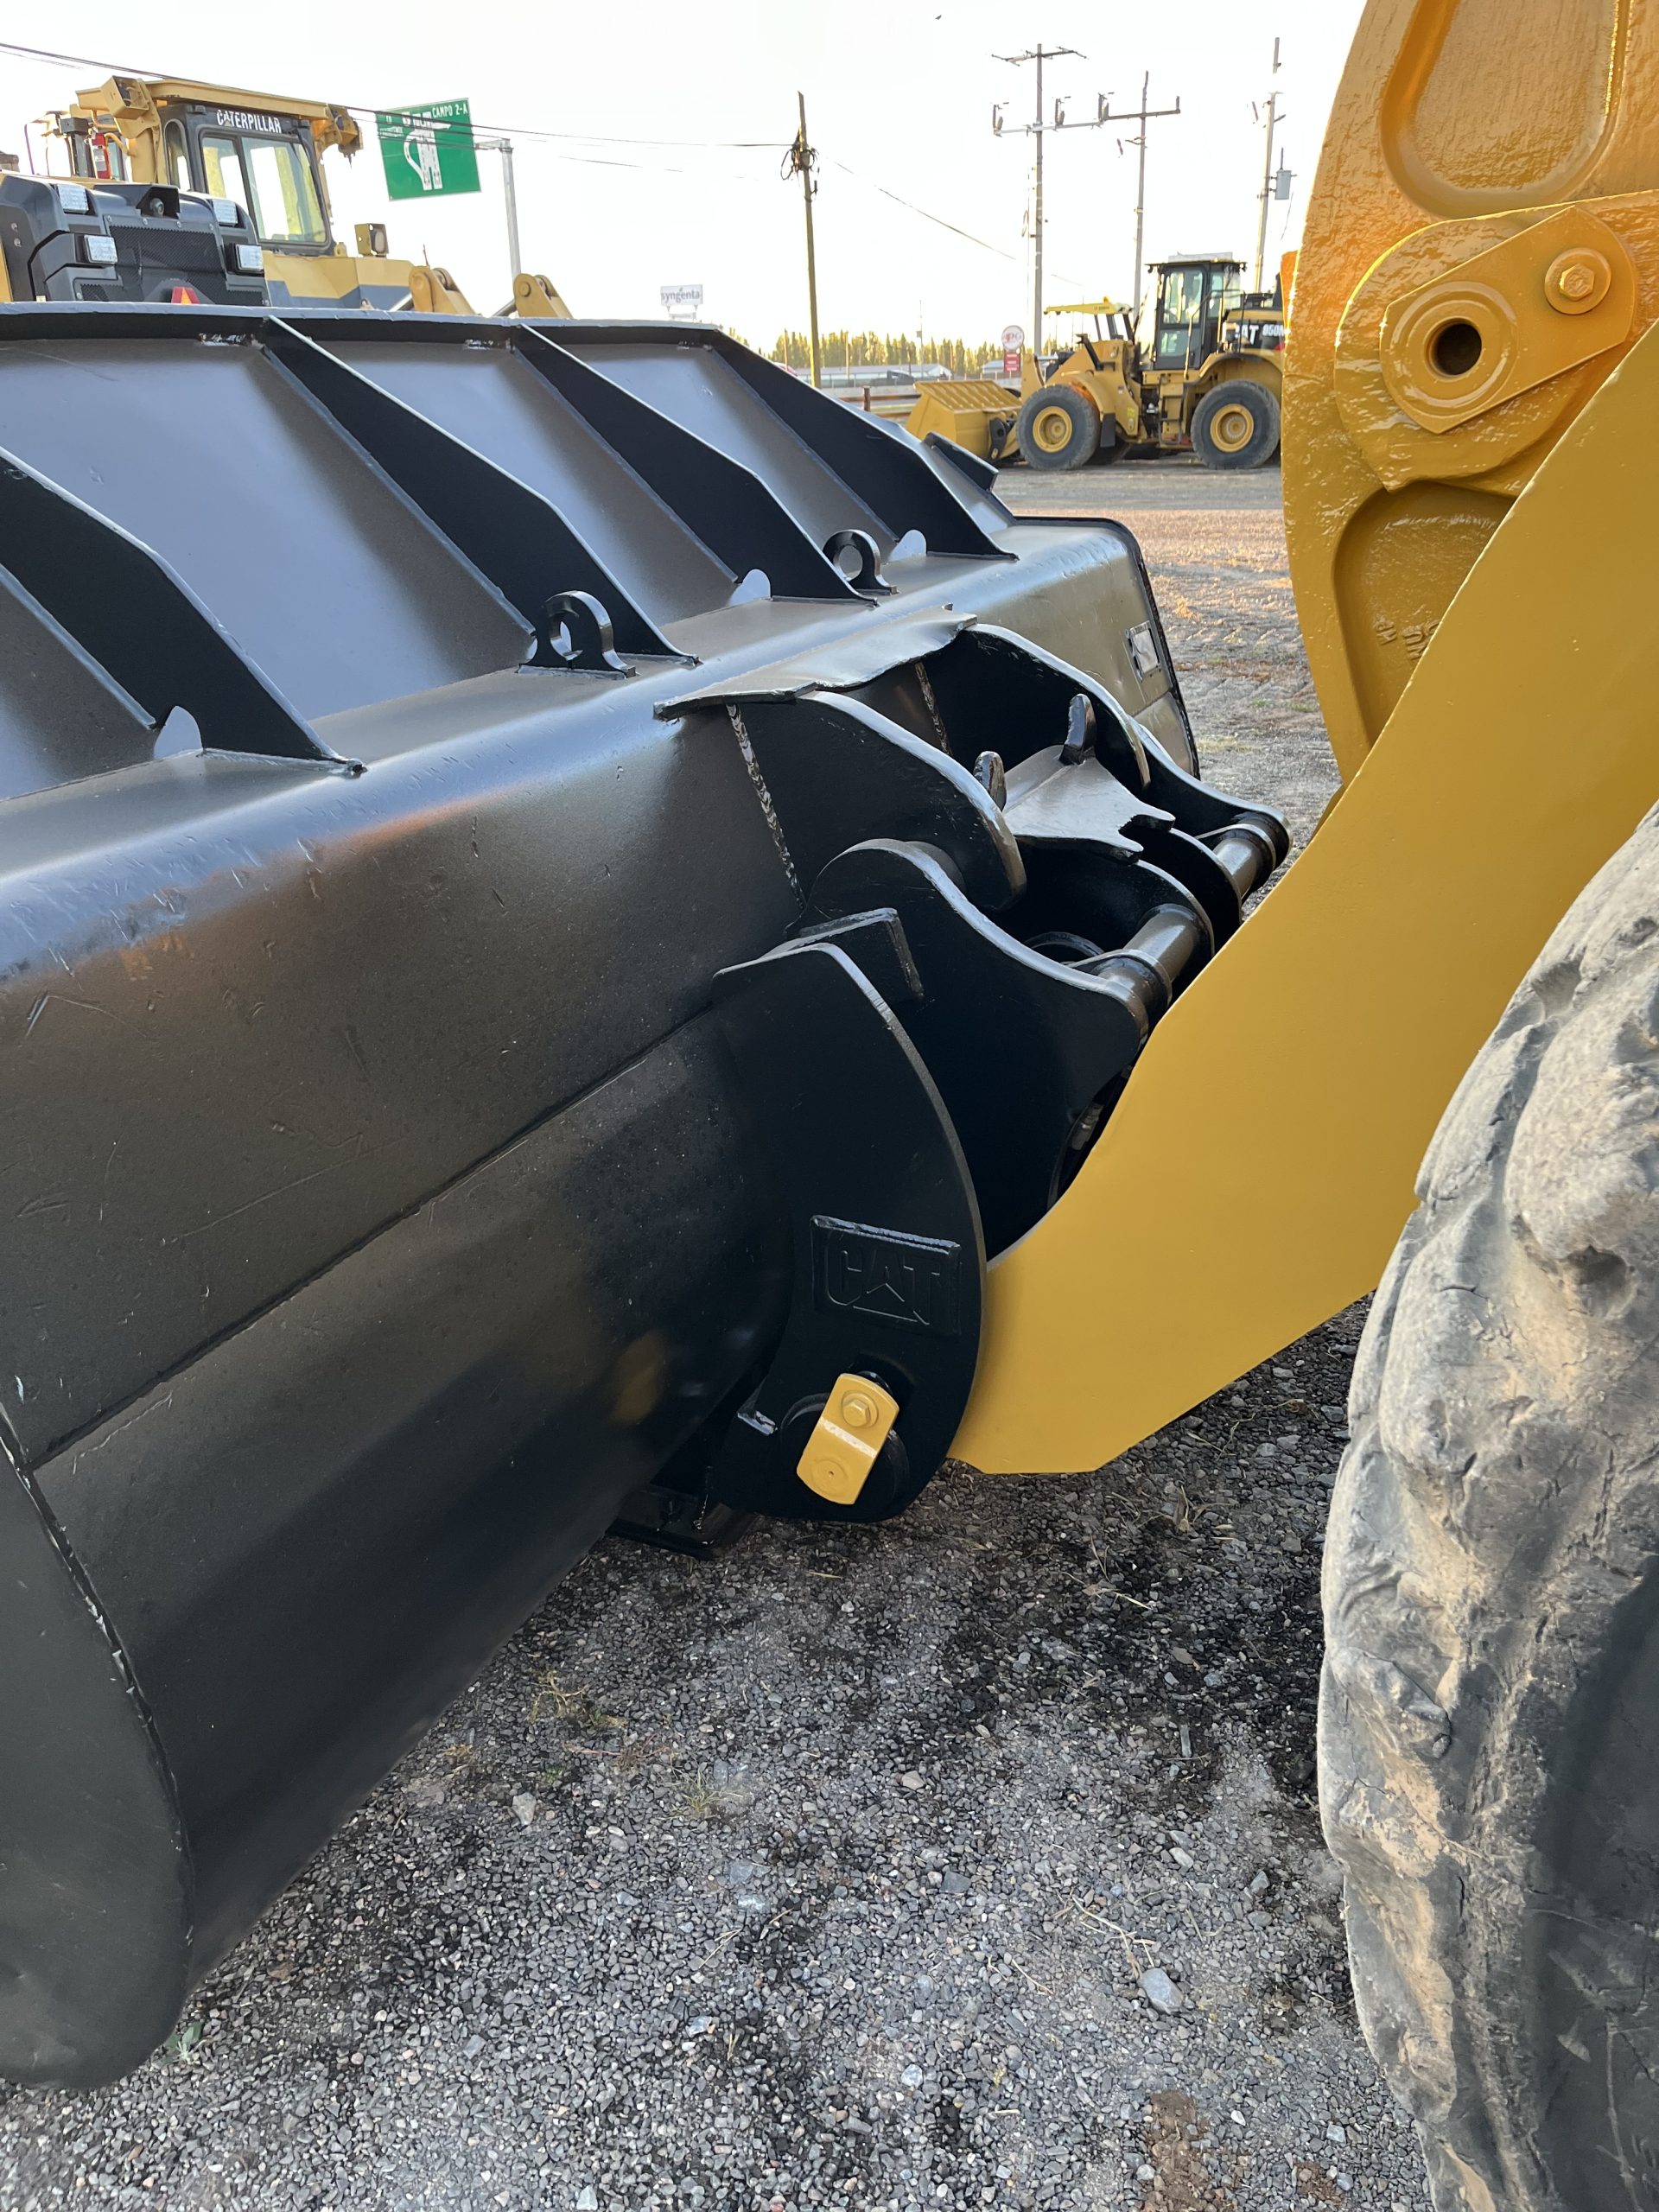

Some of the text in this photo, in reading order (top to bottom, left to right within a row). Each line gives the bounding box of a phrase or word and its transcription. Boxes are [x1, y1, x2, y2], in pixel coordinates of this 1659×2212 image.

[432, 103, 468, 118] CAMPO 2-A
[216, 109, 282, 133] CATERPILLAR
[660, 289, 700, 303] syngenta
[824, 1230, 942, 1325] CAT
